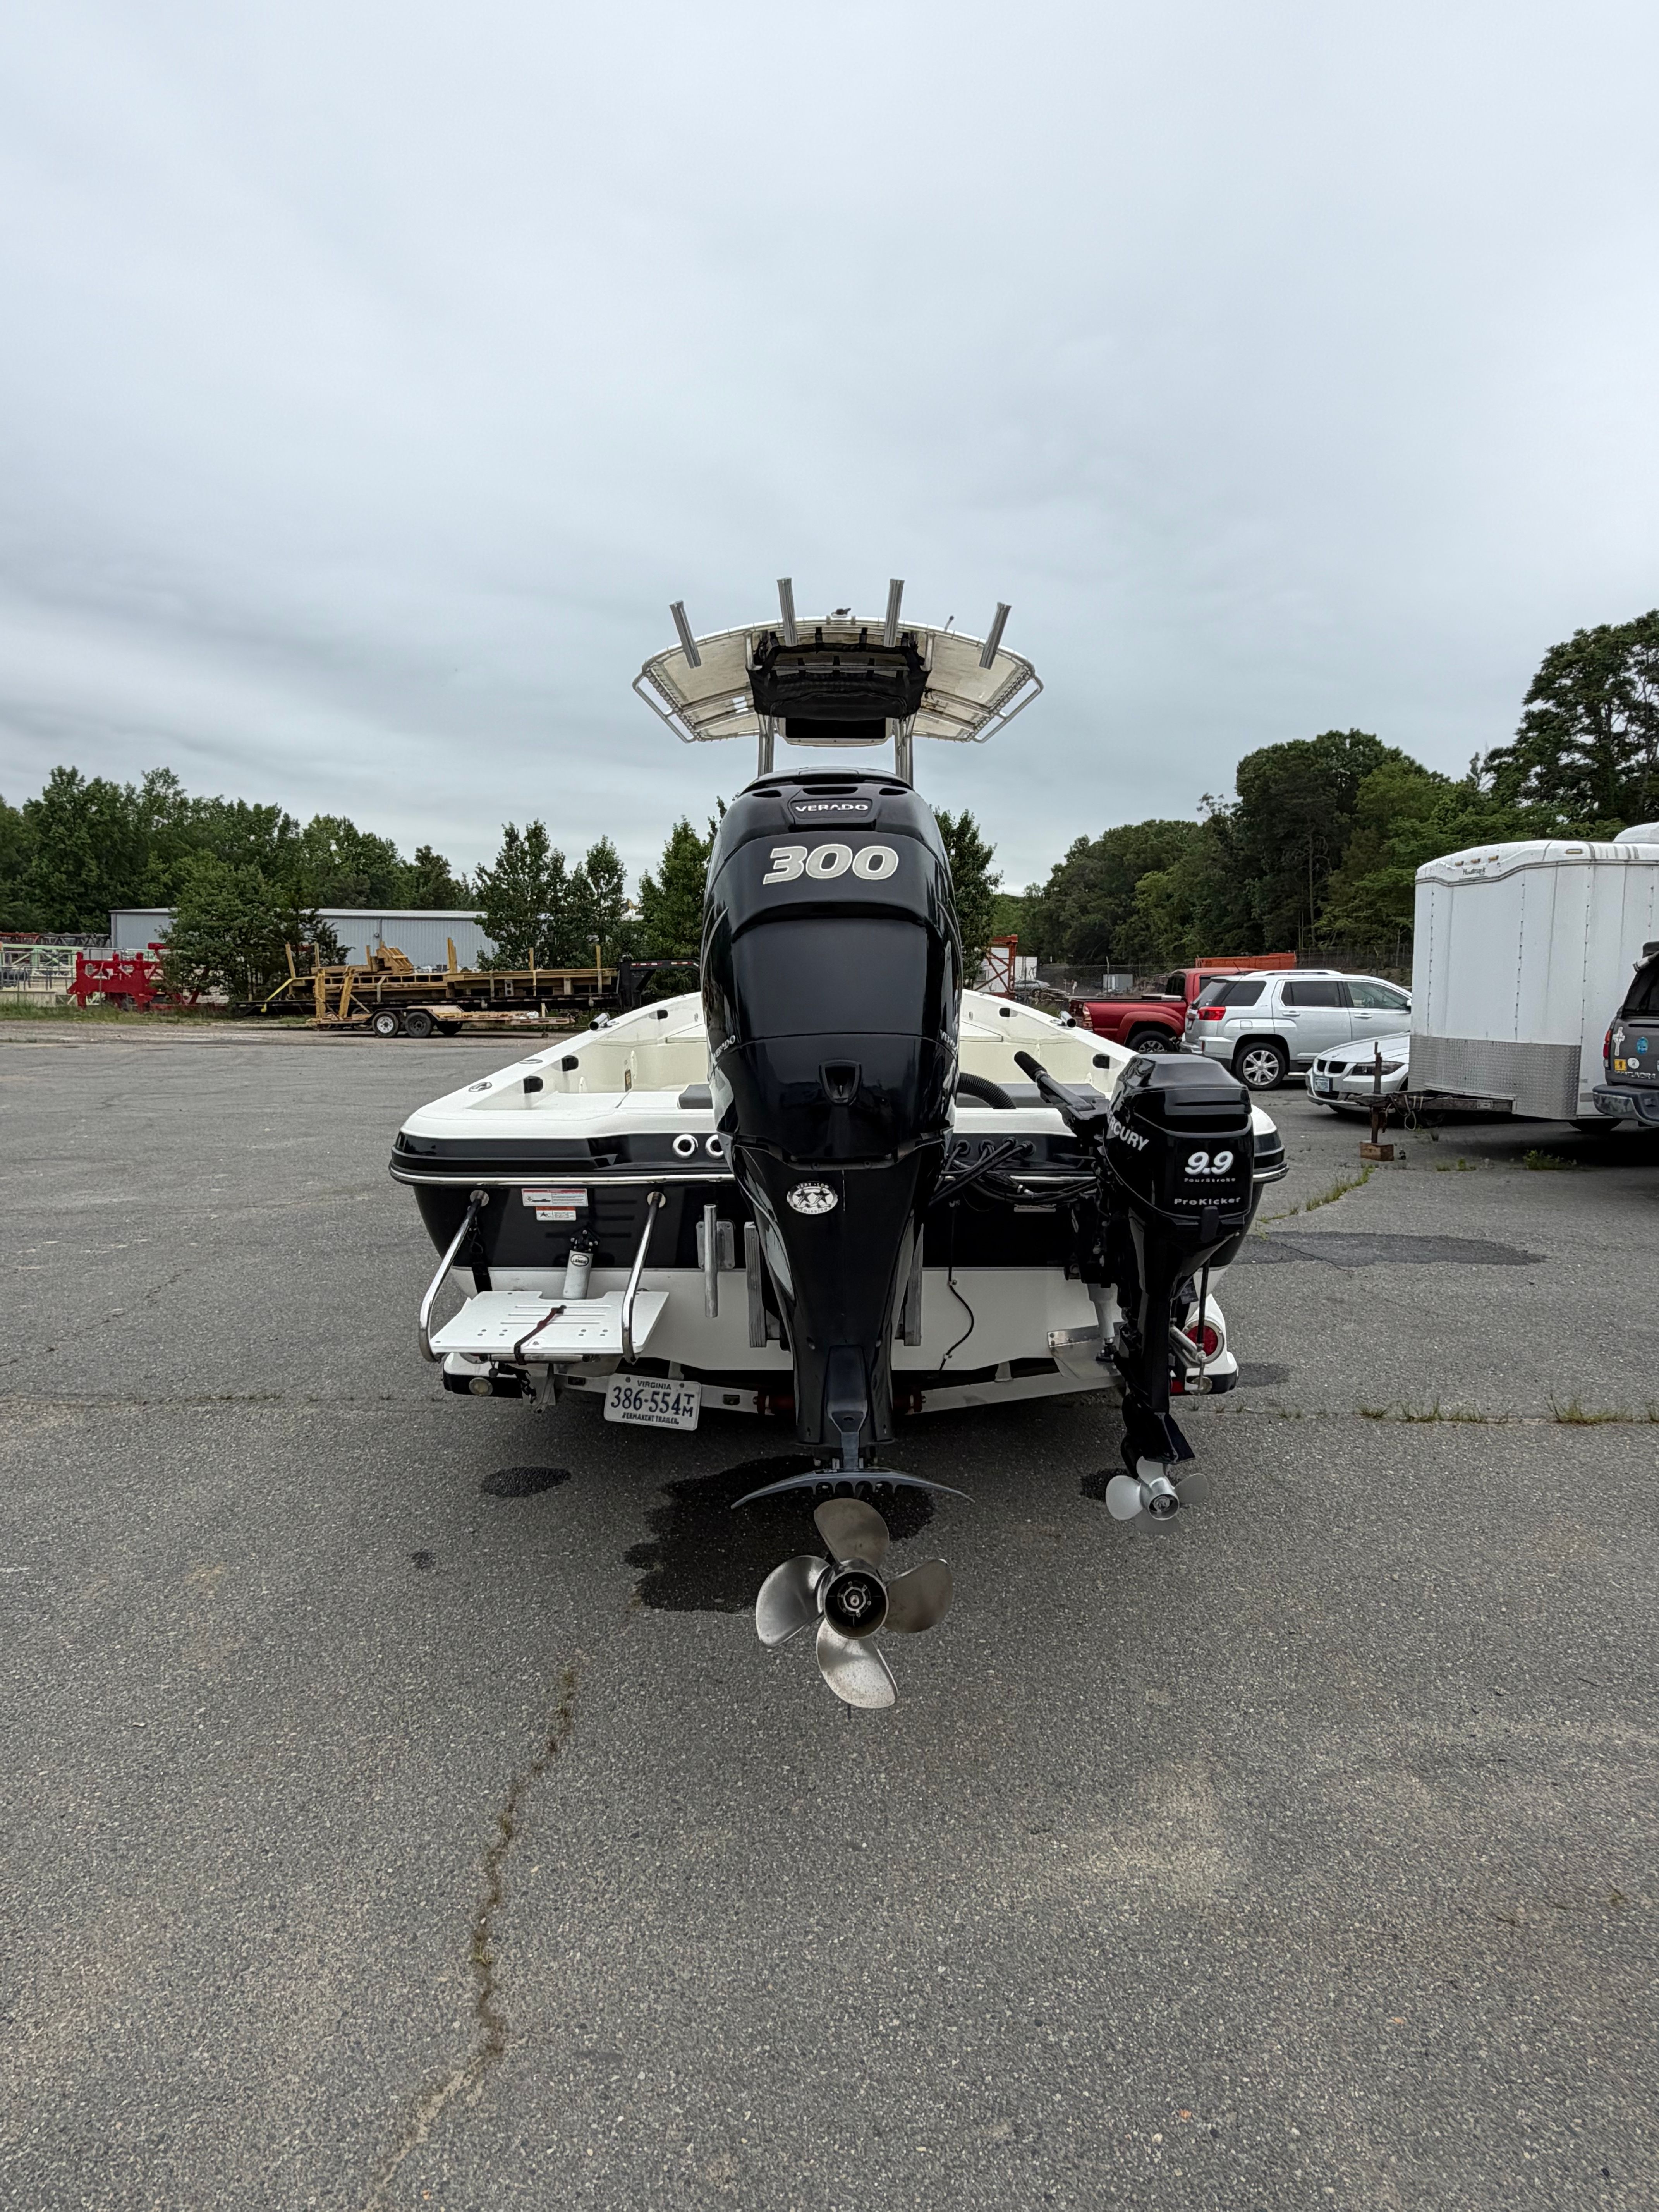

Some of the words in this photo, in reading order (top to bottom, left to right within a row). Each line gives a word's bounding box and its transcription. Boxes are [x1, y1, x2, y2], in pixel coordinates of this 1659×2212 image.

[763, 843, 898, 885] 300
[1185, 1151, 1234, 1175] 9.9
[637, 1380, 672, 1390] VIRGINIA
[611, 1386, 680, 1415] 386-554
